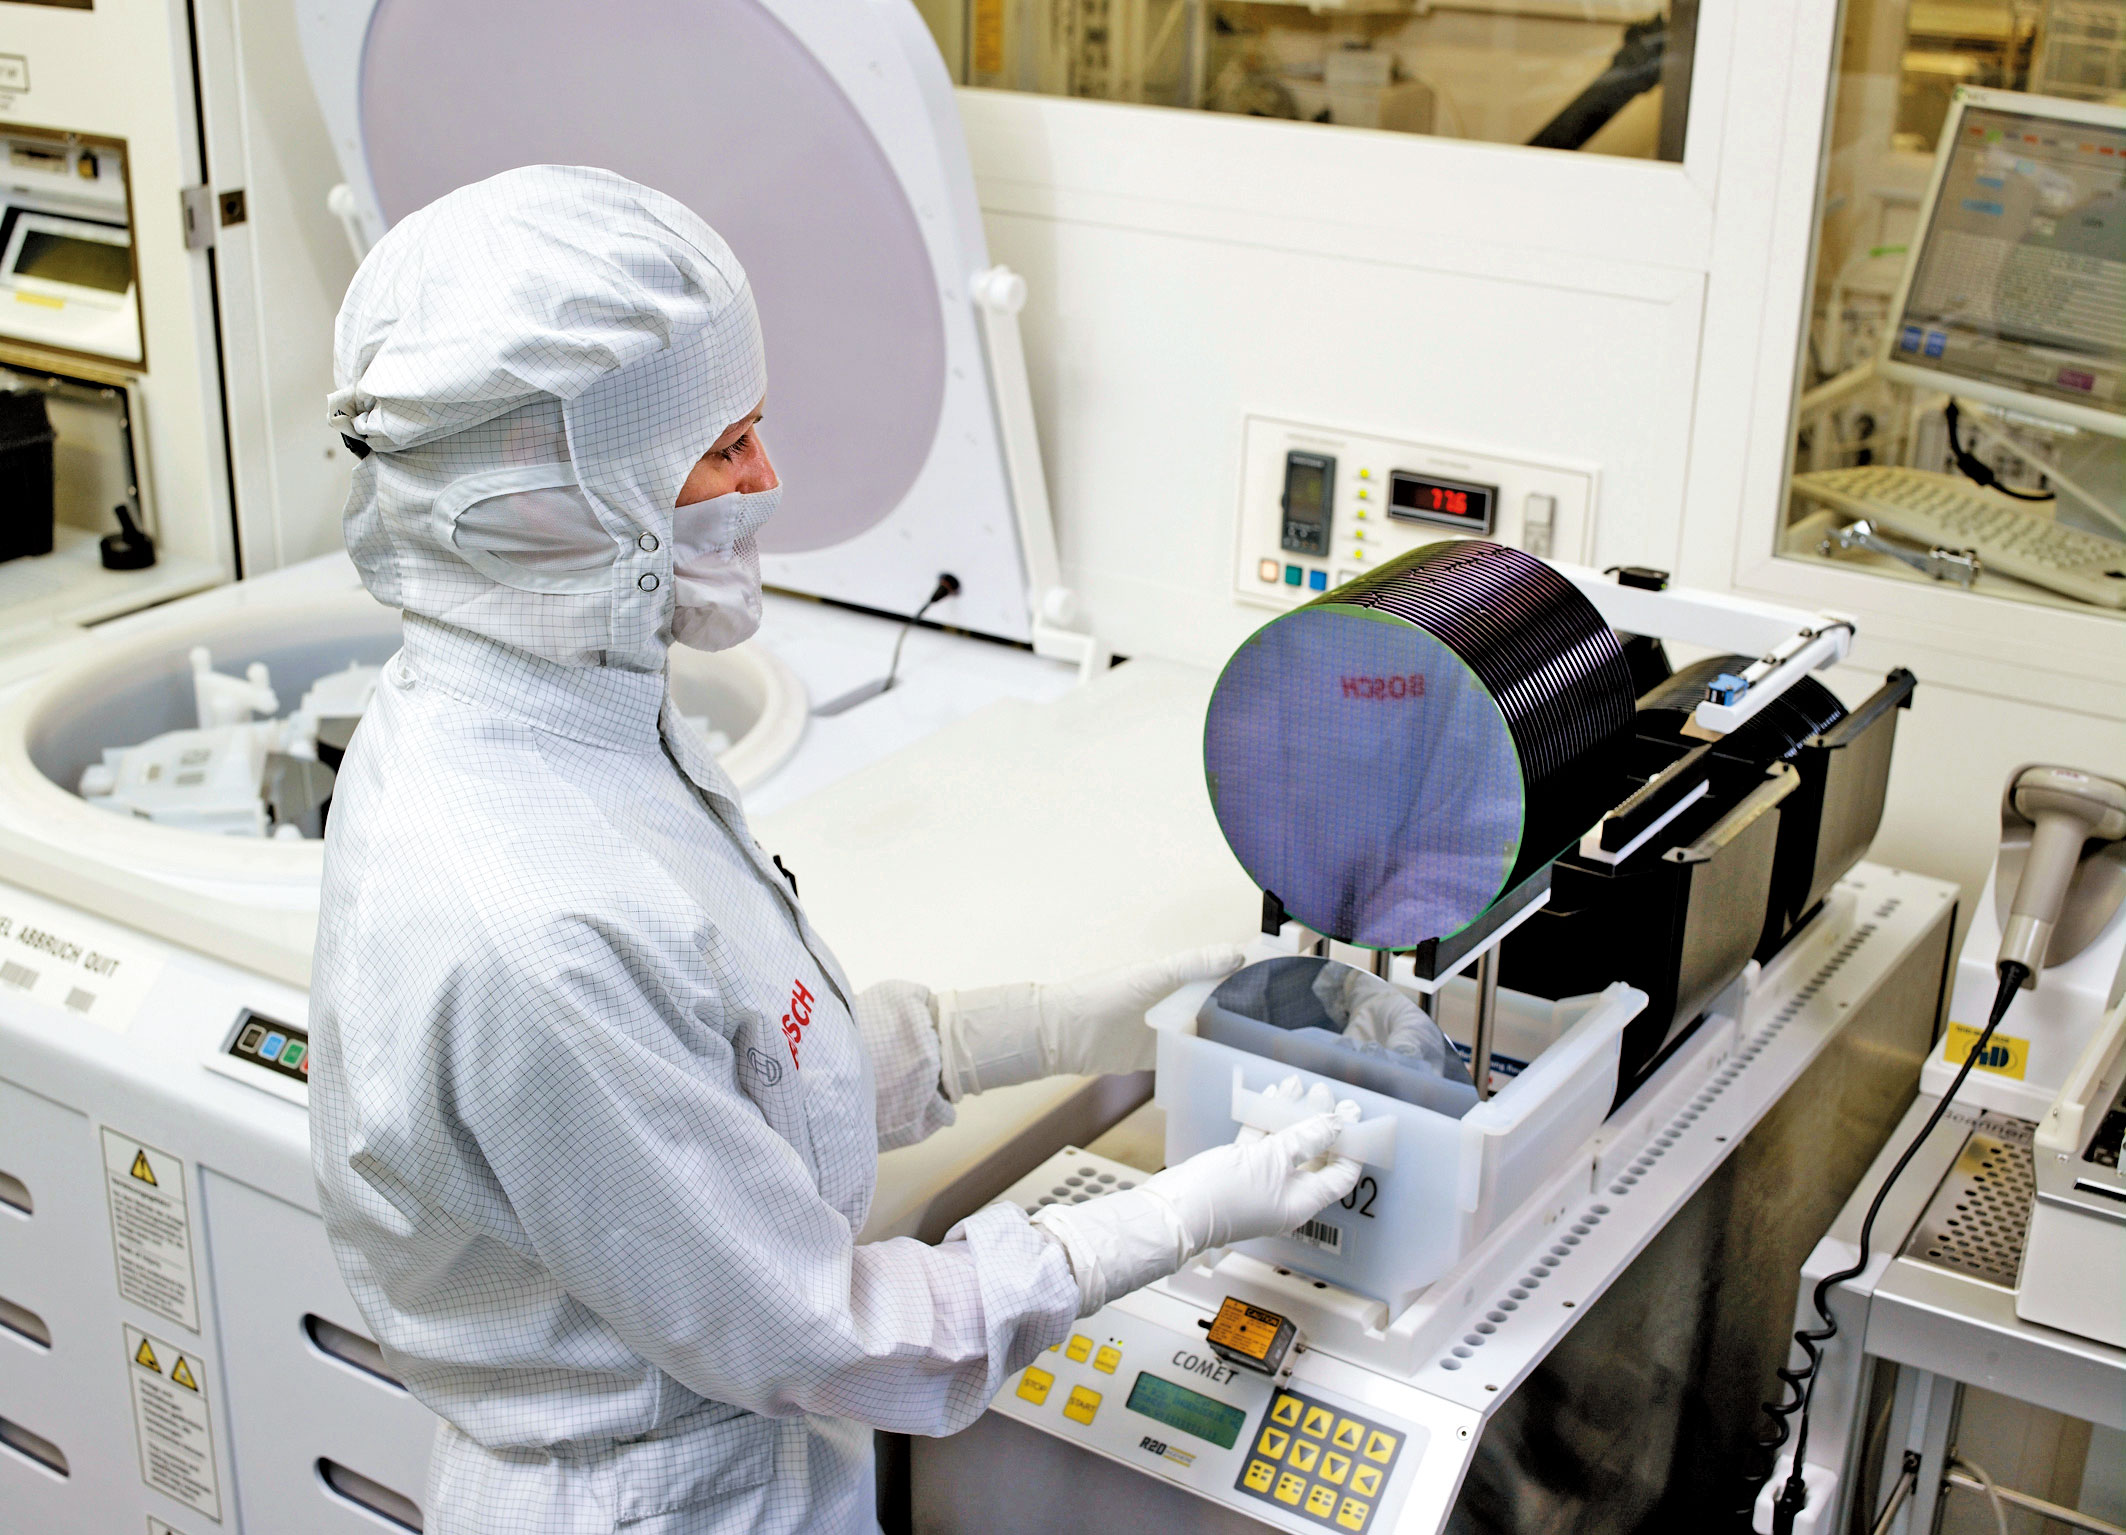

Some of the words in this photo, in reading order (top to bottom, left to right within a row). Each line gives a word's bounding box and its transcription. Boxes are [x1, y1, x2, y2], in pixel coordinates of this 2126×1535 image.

[18, 926, 83, 963] ABBRUCH
[84, 951, 119, 978] QUIT
[781, 978, 815, 1071] SCH
[1023, 1377, 1048, 1392] STOP
[1172, 1350, 1239, 1385] COMET
[1068, 1396, 1097, 1412] START
